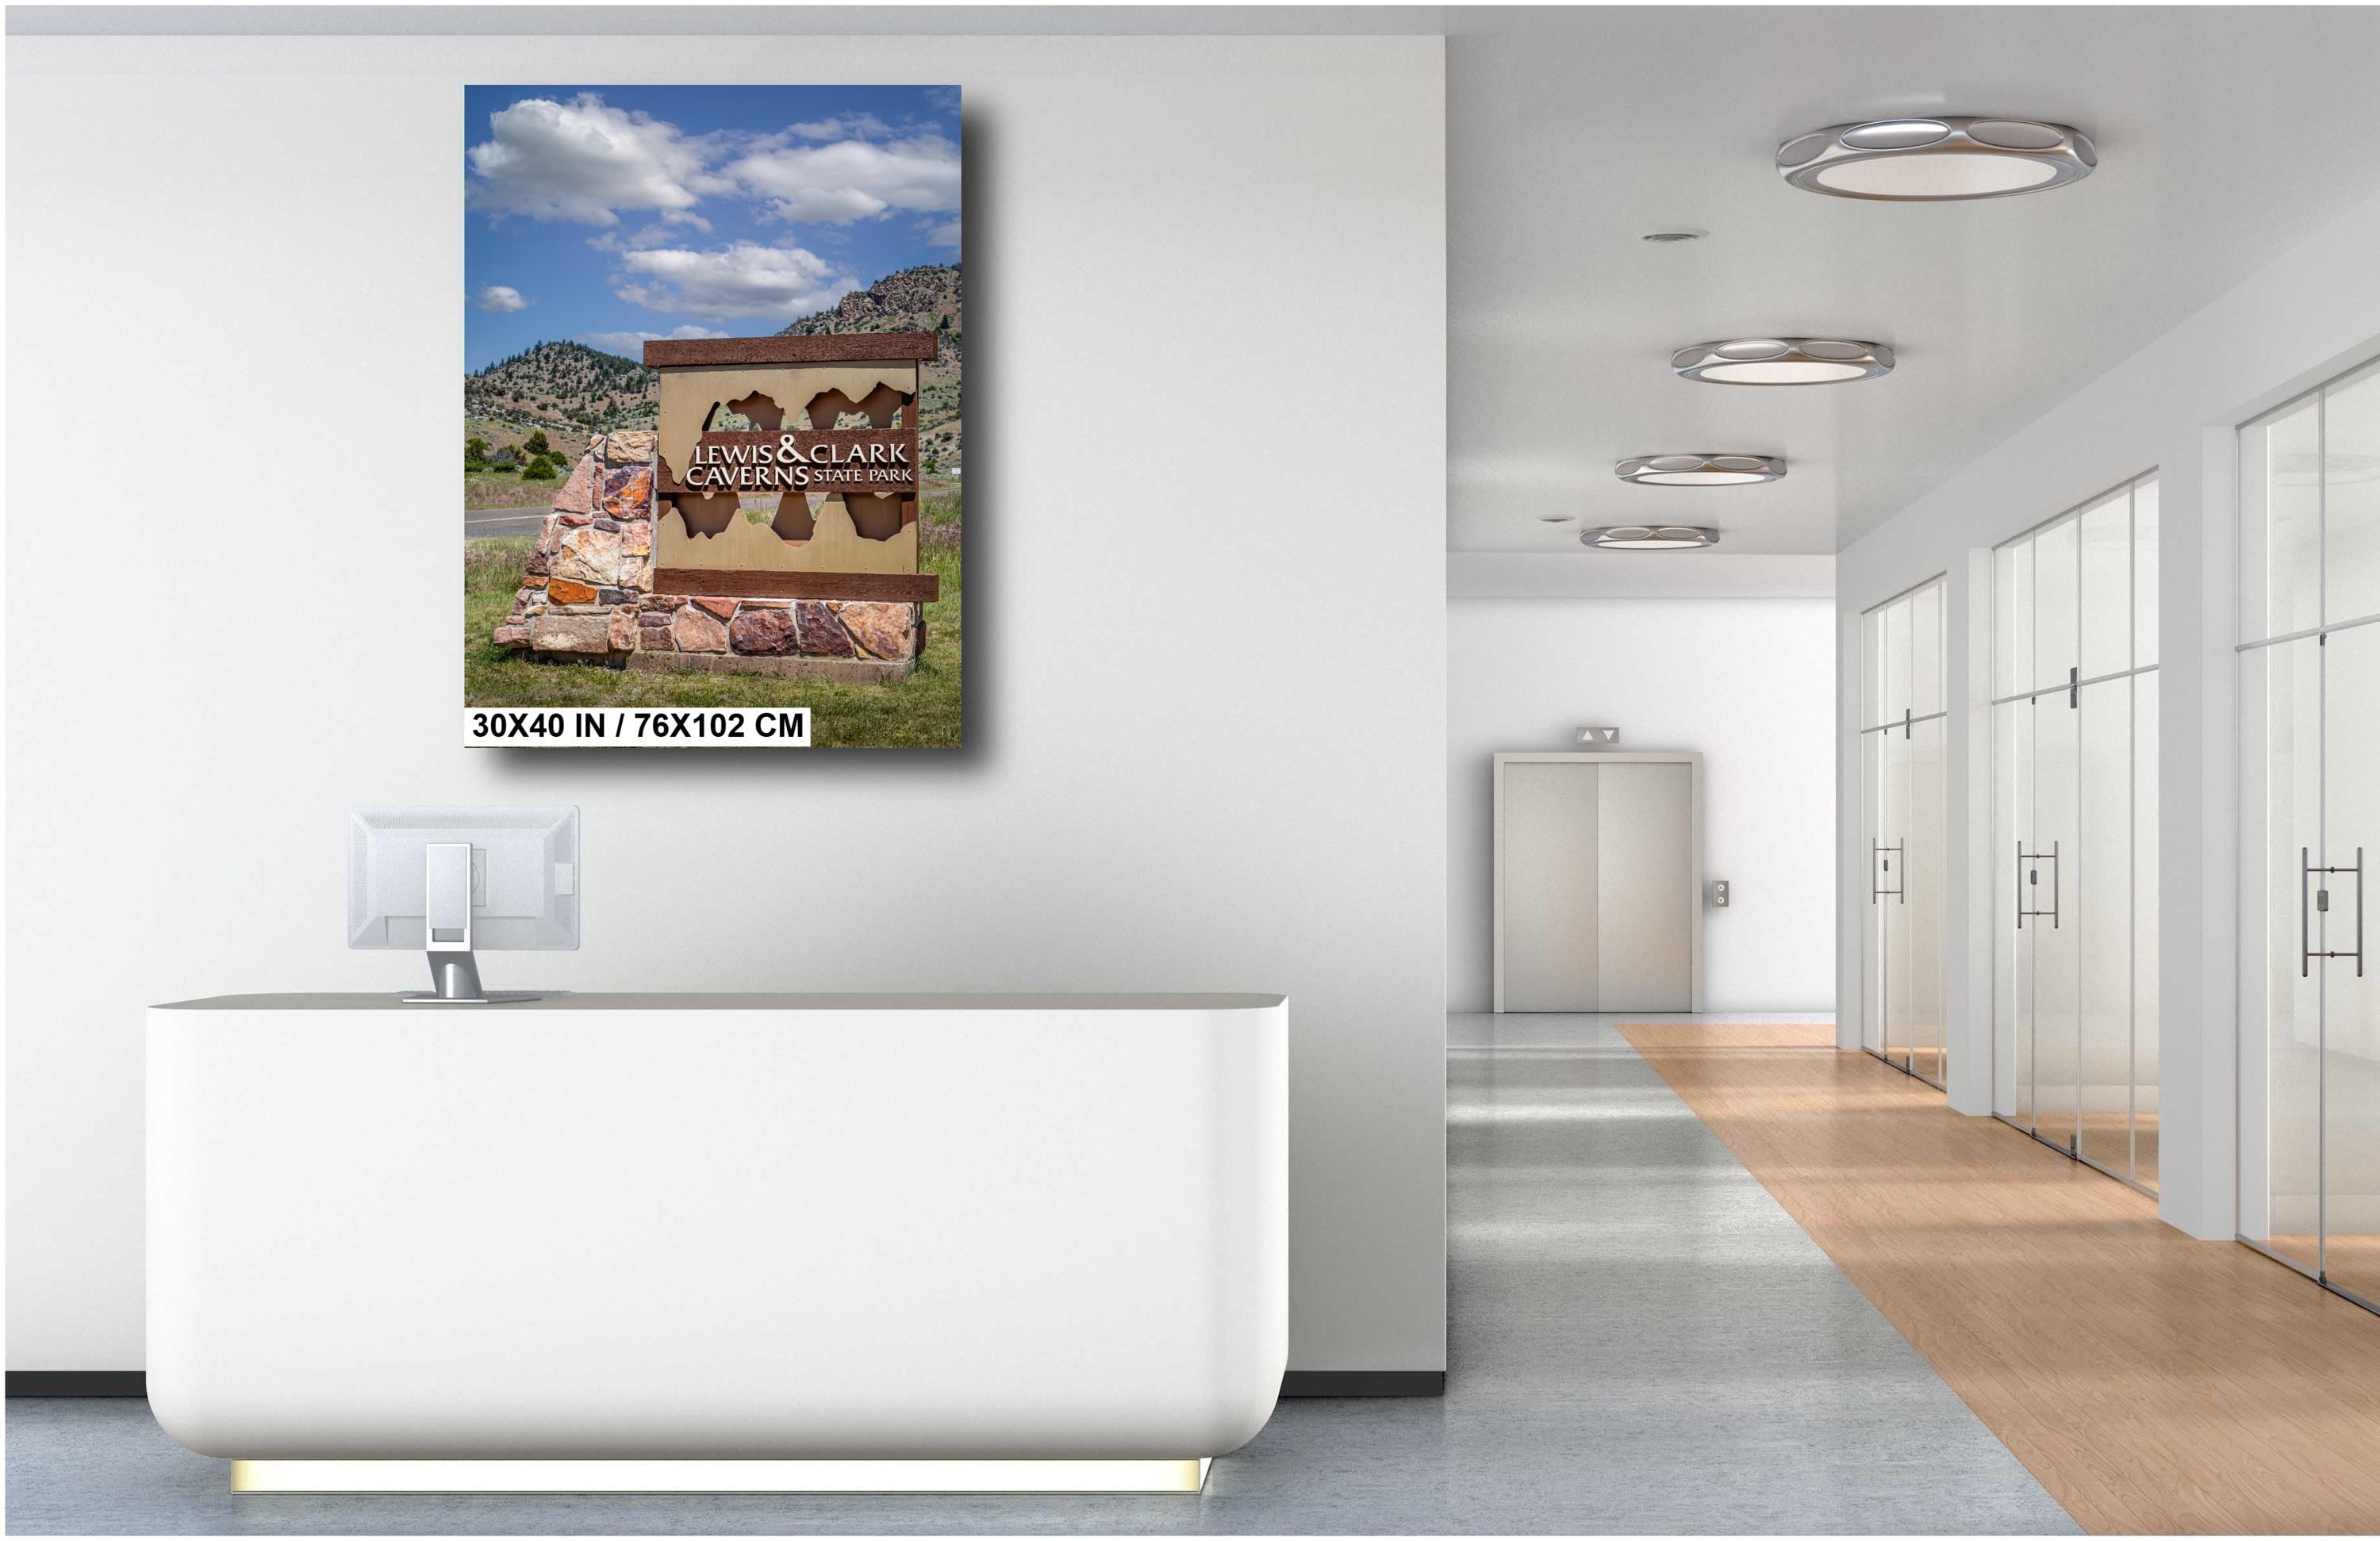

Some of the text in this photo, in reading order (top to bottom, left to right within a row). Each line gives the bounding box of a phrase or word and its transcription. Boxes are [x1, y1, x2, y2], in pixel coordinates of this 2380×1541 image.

[695, 434, 909, 464] LEWIS & CLARK
[686, 466, 914, 486] CAVERNS STATE PARK
